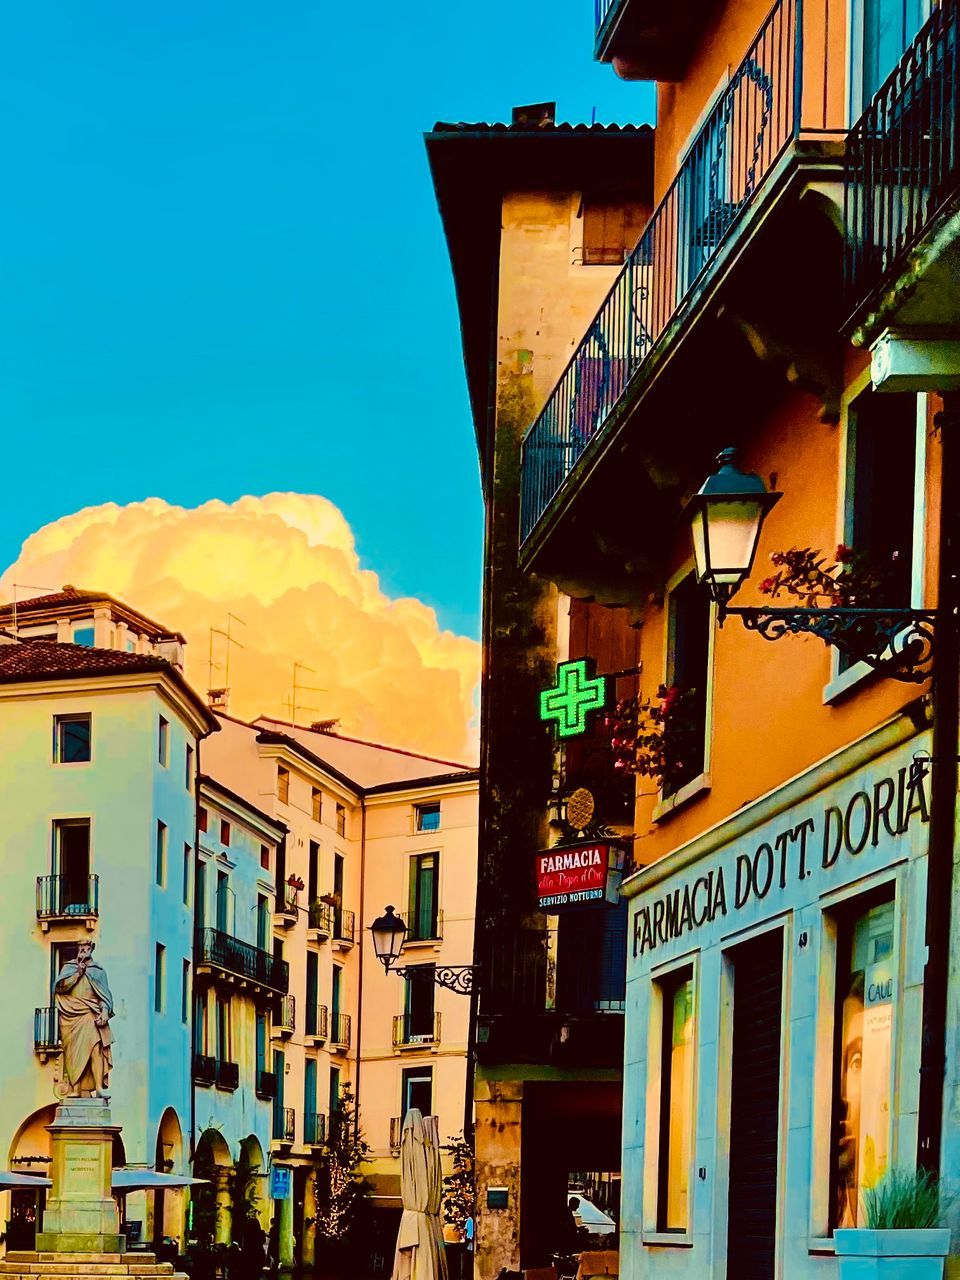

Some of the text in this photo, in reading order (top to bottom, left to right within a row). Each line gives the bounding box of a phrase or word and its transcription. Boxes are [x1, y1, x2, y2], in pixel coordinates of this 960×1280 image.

[540, 849, 602, 874] FARMACIA
[633, 762, 930, 958] FARMACIA DOTT. DORIA
[539, 889, 603, 907] SERVIZIO NOTTURNO
